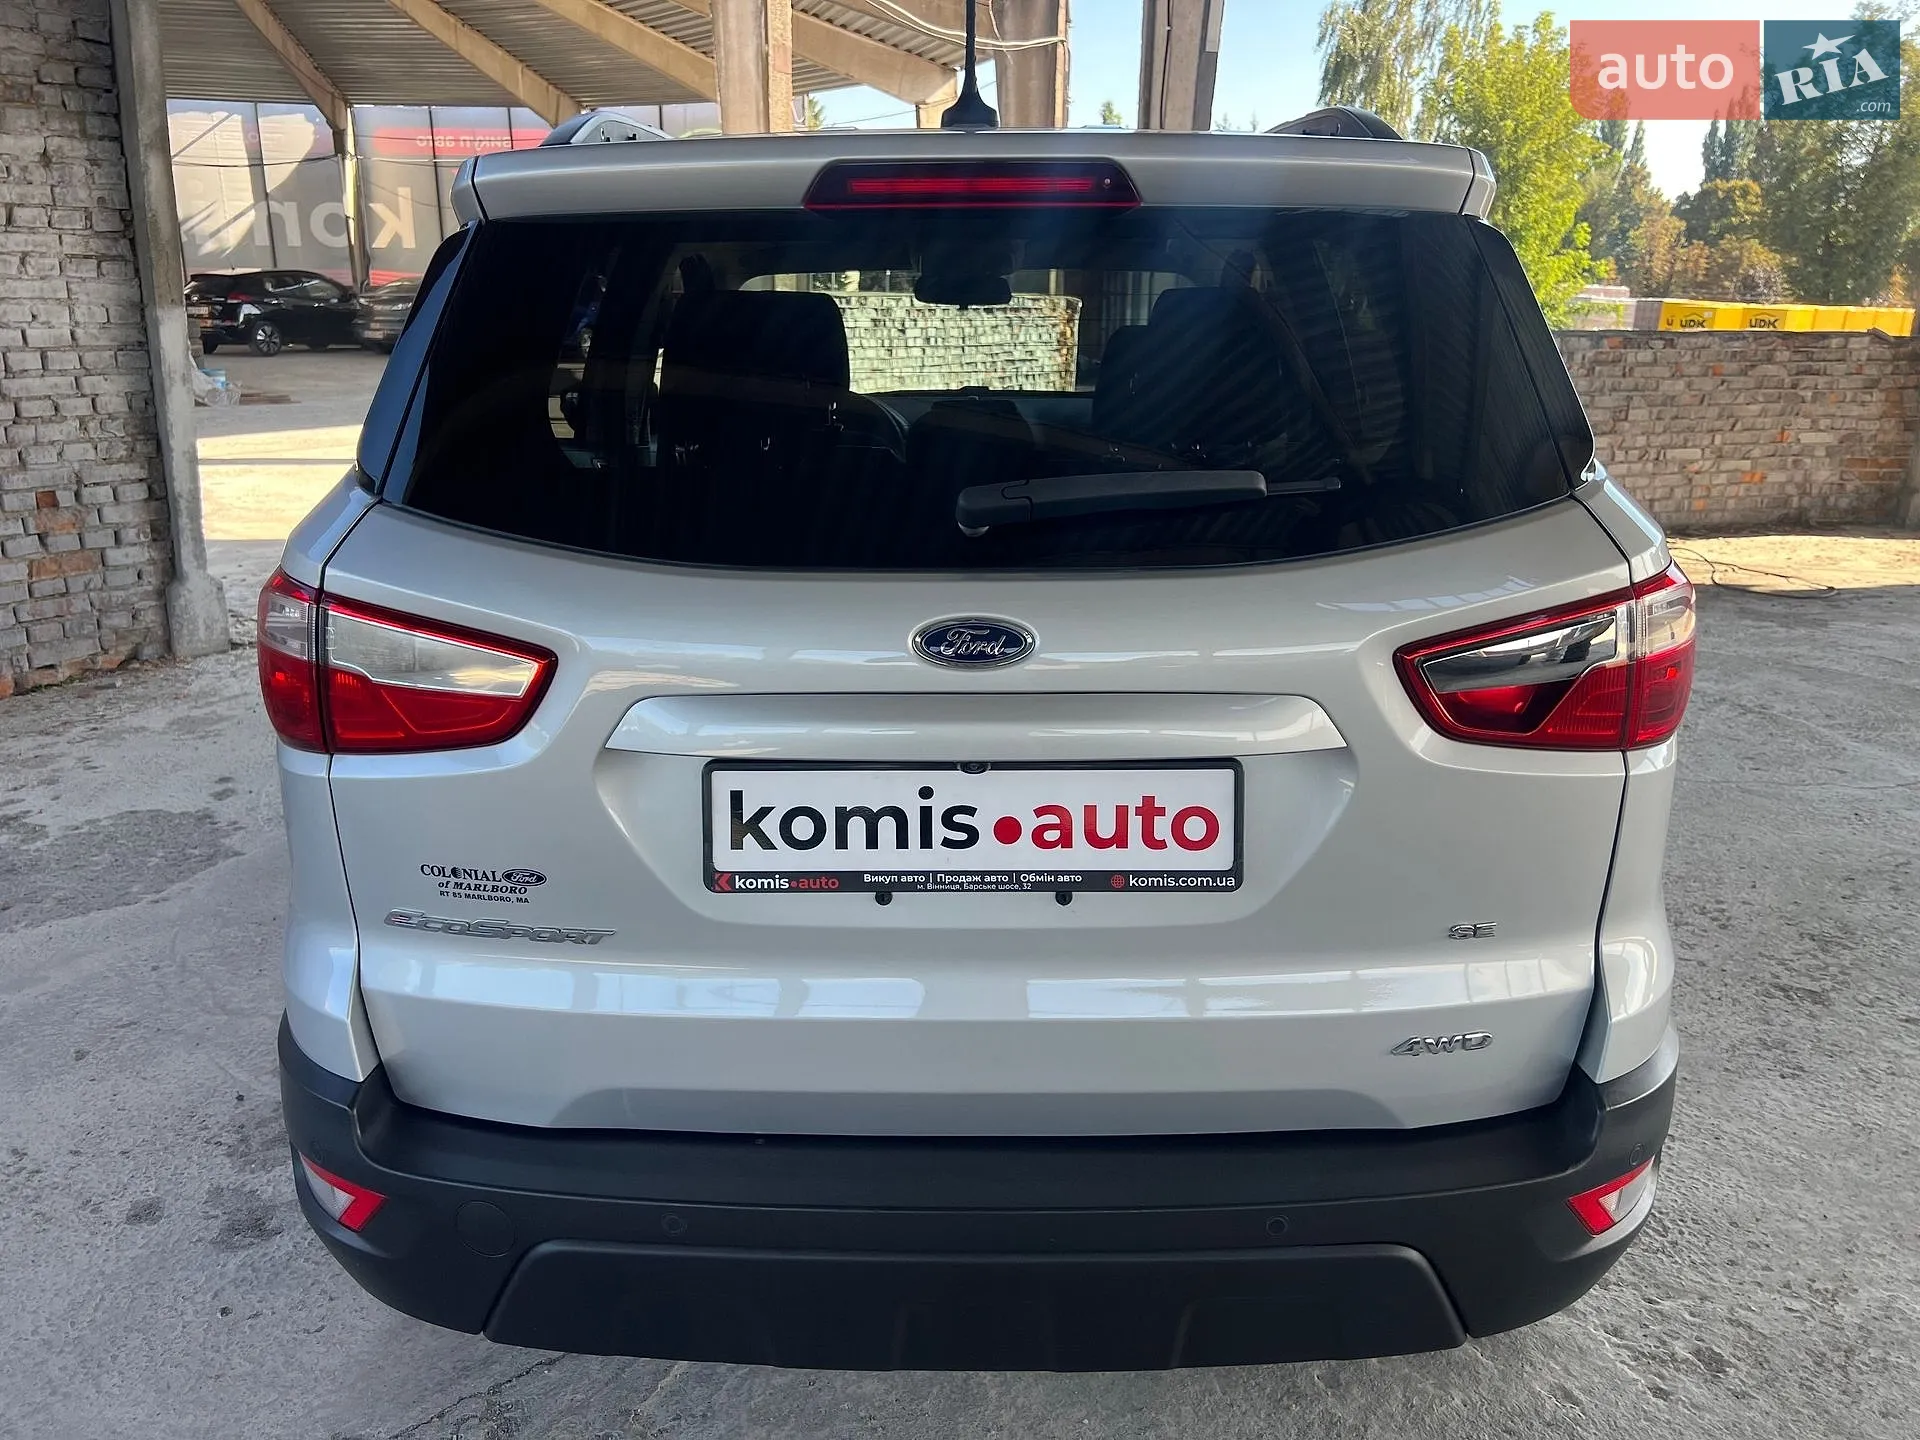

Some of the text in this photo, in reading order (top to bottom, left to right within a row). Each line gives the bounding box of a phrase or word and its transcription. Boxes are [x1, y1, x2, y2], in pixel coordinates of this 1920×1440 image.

[940, 627, 1007, 656] Ford
[729, 786, 1220, 851] komis auto
[420, 864, 502, 883] COLONIAL
[863, 873, 898, 884] Викуп
[937, 873, 982, 884] Продаж
[1020, 873, 1055, 882] Обмін
[1129, 874, 1236, 887] komis.com.ua
[438, 881, 528, 895] of MARLBORO
[735, 874, 839, 889] komis auto
[927, 883, 961, 891] Вінниця,
[963, 883, 996, 891] Барське
[464, 893, 514, 904] MARLBORO,
[1448, 922, 1497, 940] SE
[1391, 1030, 1493, 1056] 4WD
